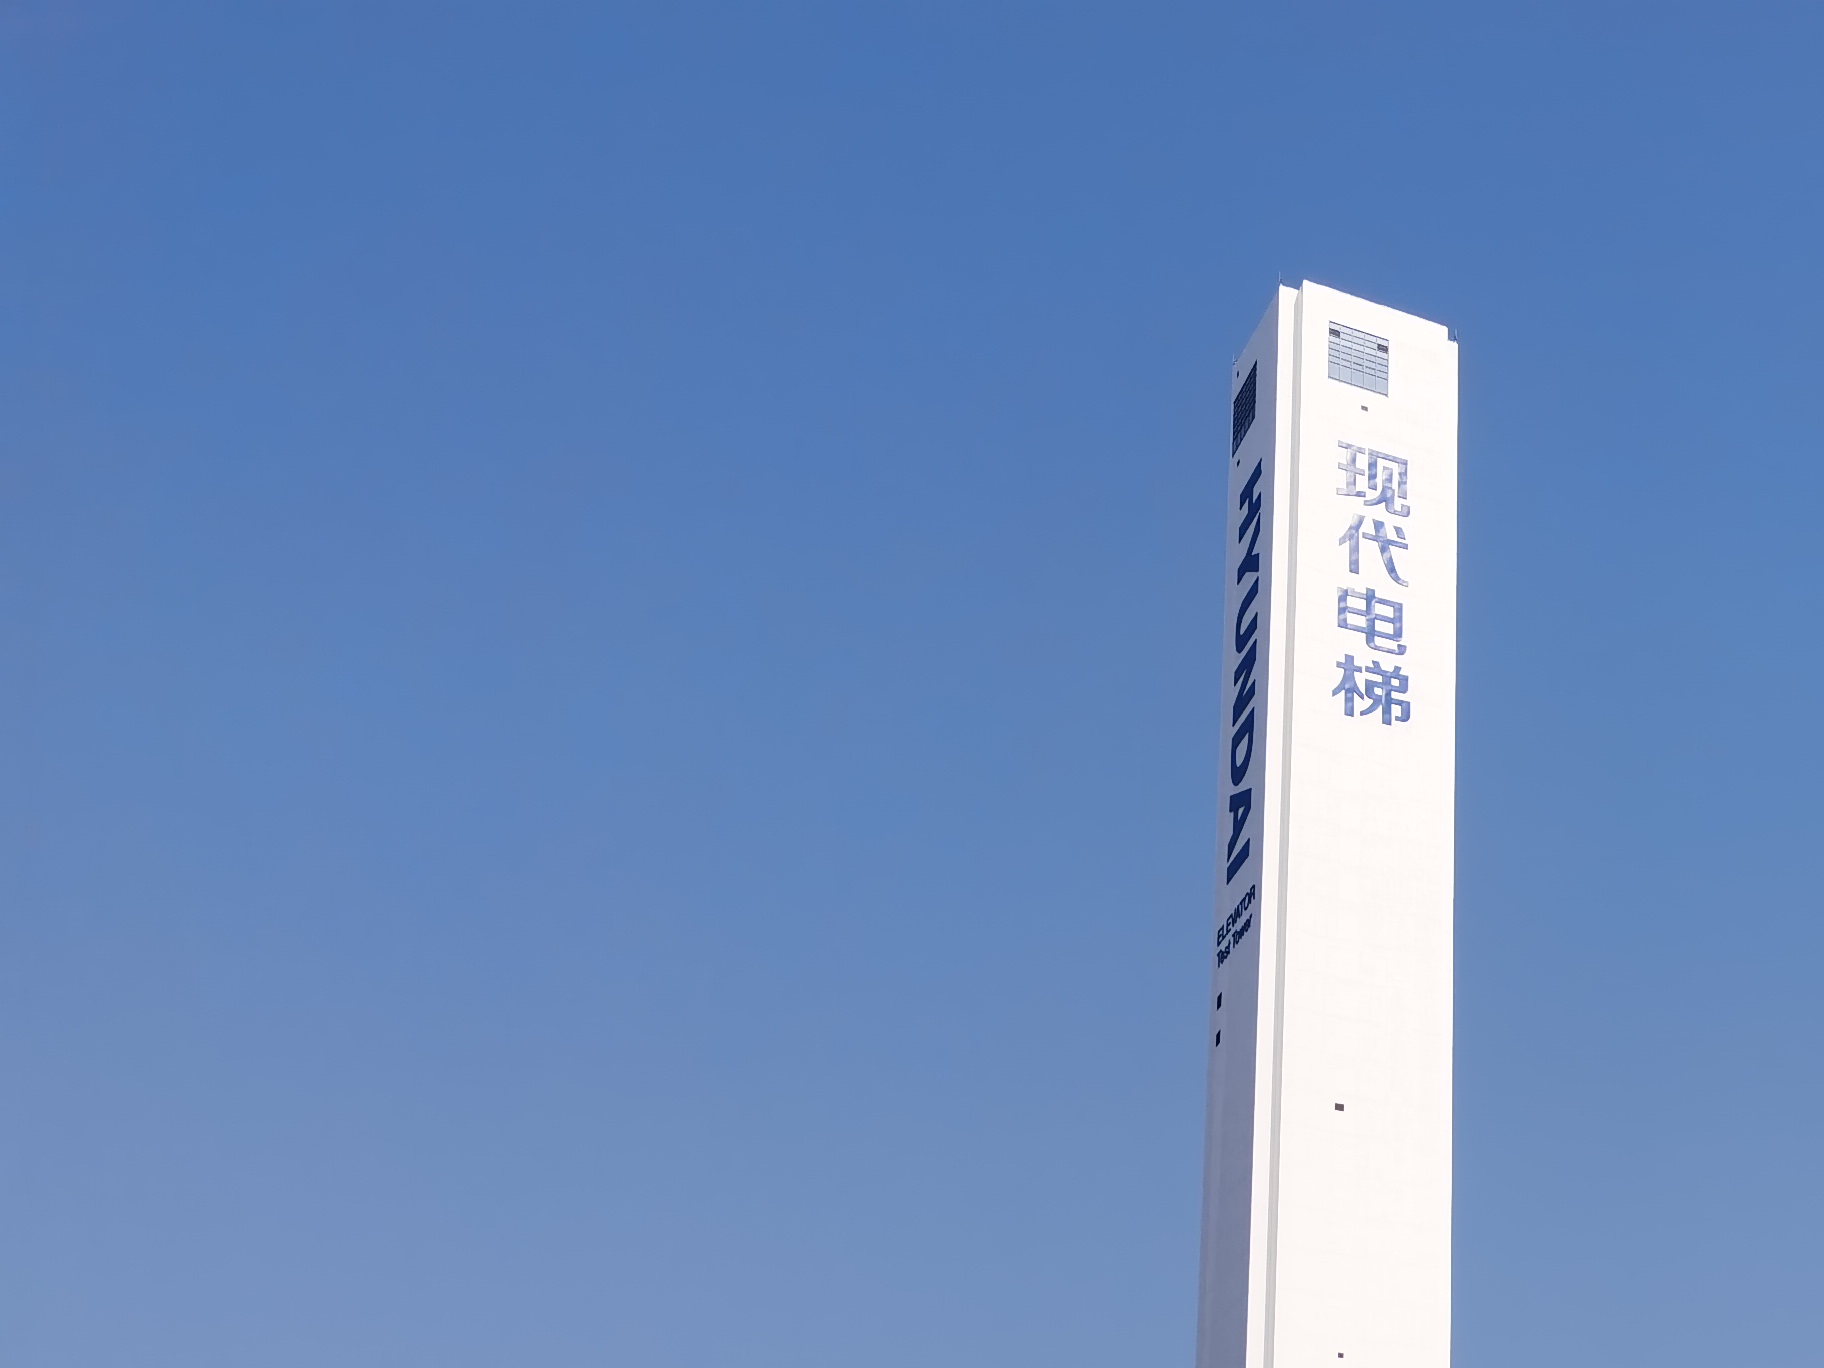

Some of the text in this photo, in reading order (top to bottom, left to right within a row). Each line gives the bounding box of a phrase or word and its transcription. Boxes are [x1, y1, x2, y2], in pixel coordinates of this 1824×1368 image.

[1331, 439, 1411, 726] 现代电梯
[1226, 458, 1263, 886] HYUNDAI
[1216, 884, 1256, 948] ELEVATOR
[1216, 913, 1253, 968] Test Tower
